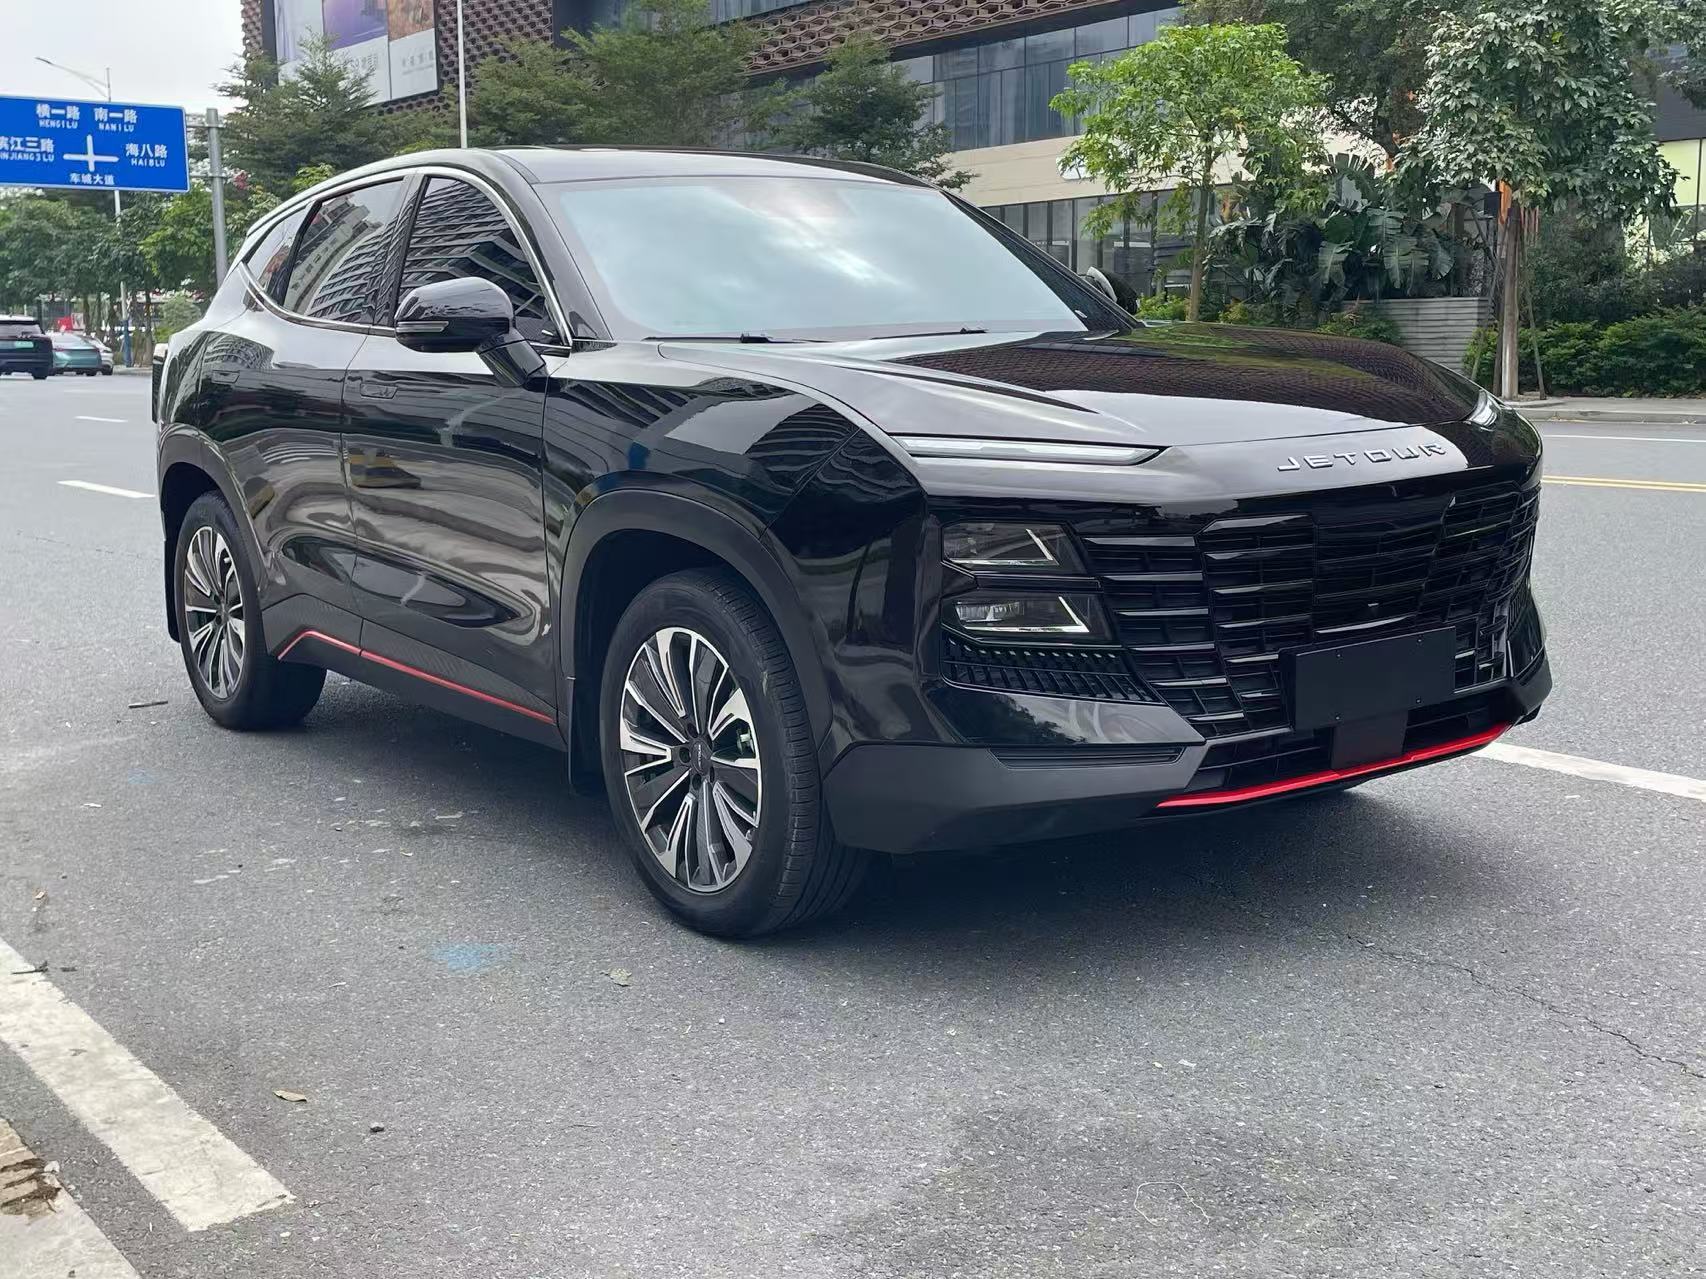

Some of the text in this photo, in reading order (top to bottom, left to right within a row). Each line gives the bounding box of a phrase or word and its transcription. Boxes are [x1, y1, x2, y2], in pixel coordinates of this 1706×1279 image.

[36, 103, 80, 120] 横一路
[94, 108, 138, 123] 南一路
[125, 143, 168, 158] 海八路
[69, 172, 115, 185] 车城大道
[1277, 443, 1446, 472] JETOUR
